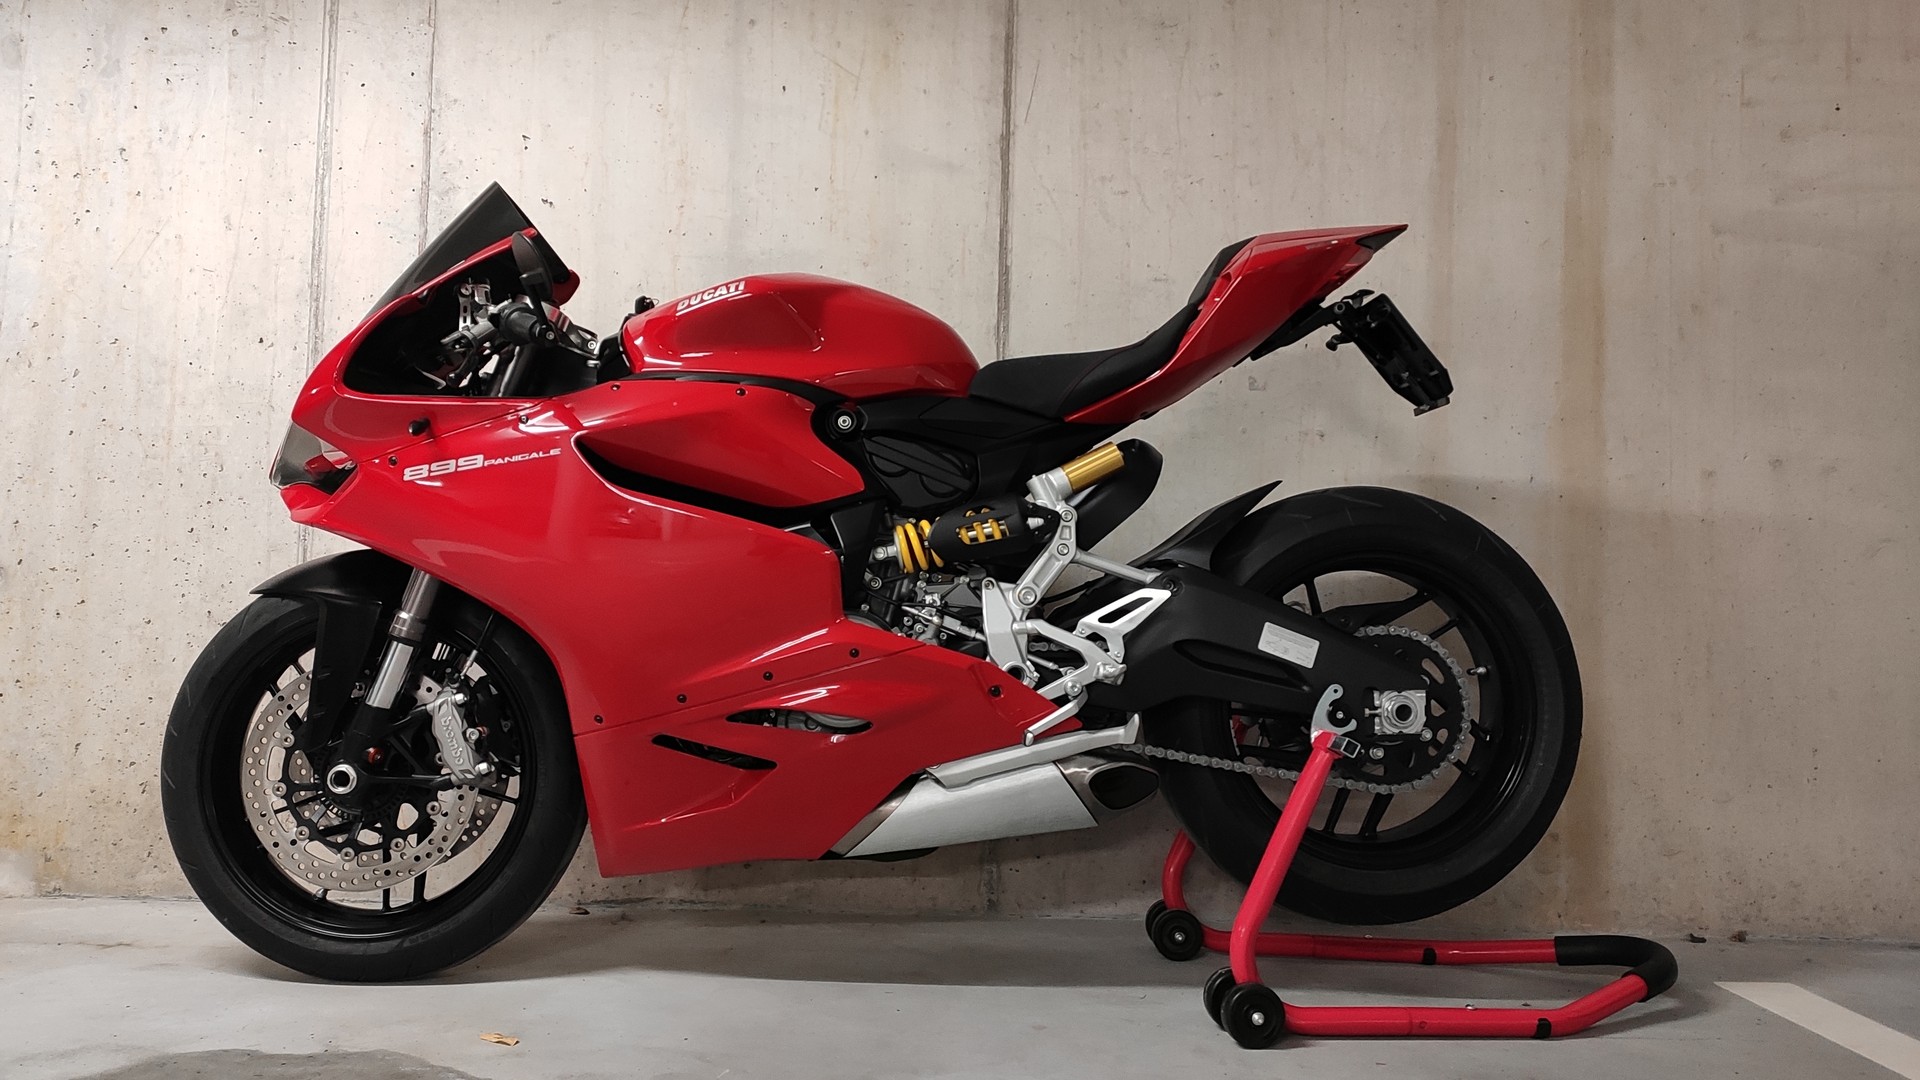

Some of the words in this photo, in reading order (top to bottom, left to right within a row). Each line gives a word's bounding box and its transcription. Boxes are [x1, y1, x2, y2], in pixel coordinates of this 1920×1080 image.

[676, 280, 746, 311] DUCATI
[402, 454, 485, 482] 899
[484, 447, 562, 467] PANIGALE
[440, 715, 464, 766] brembo
